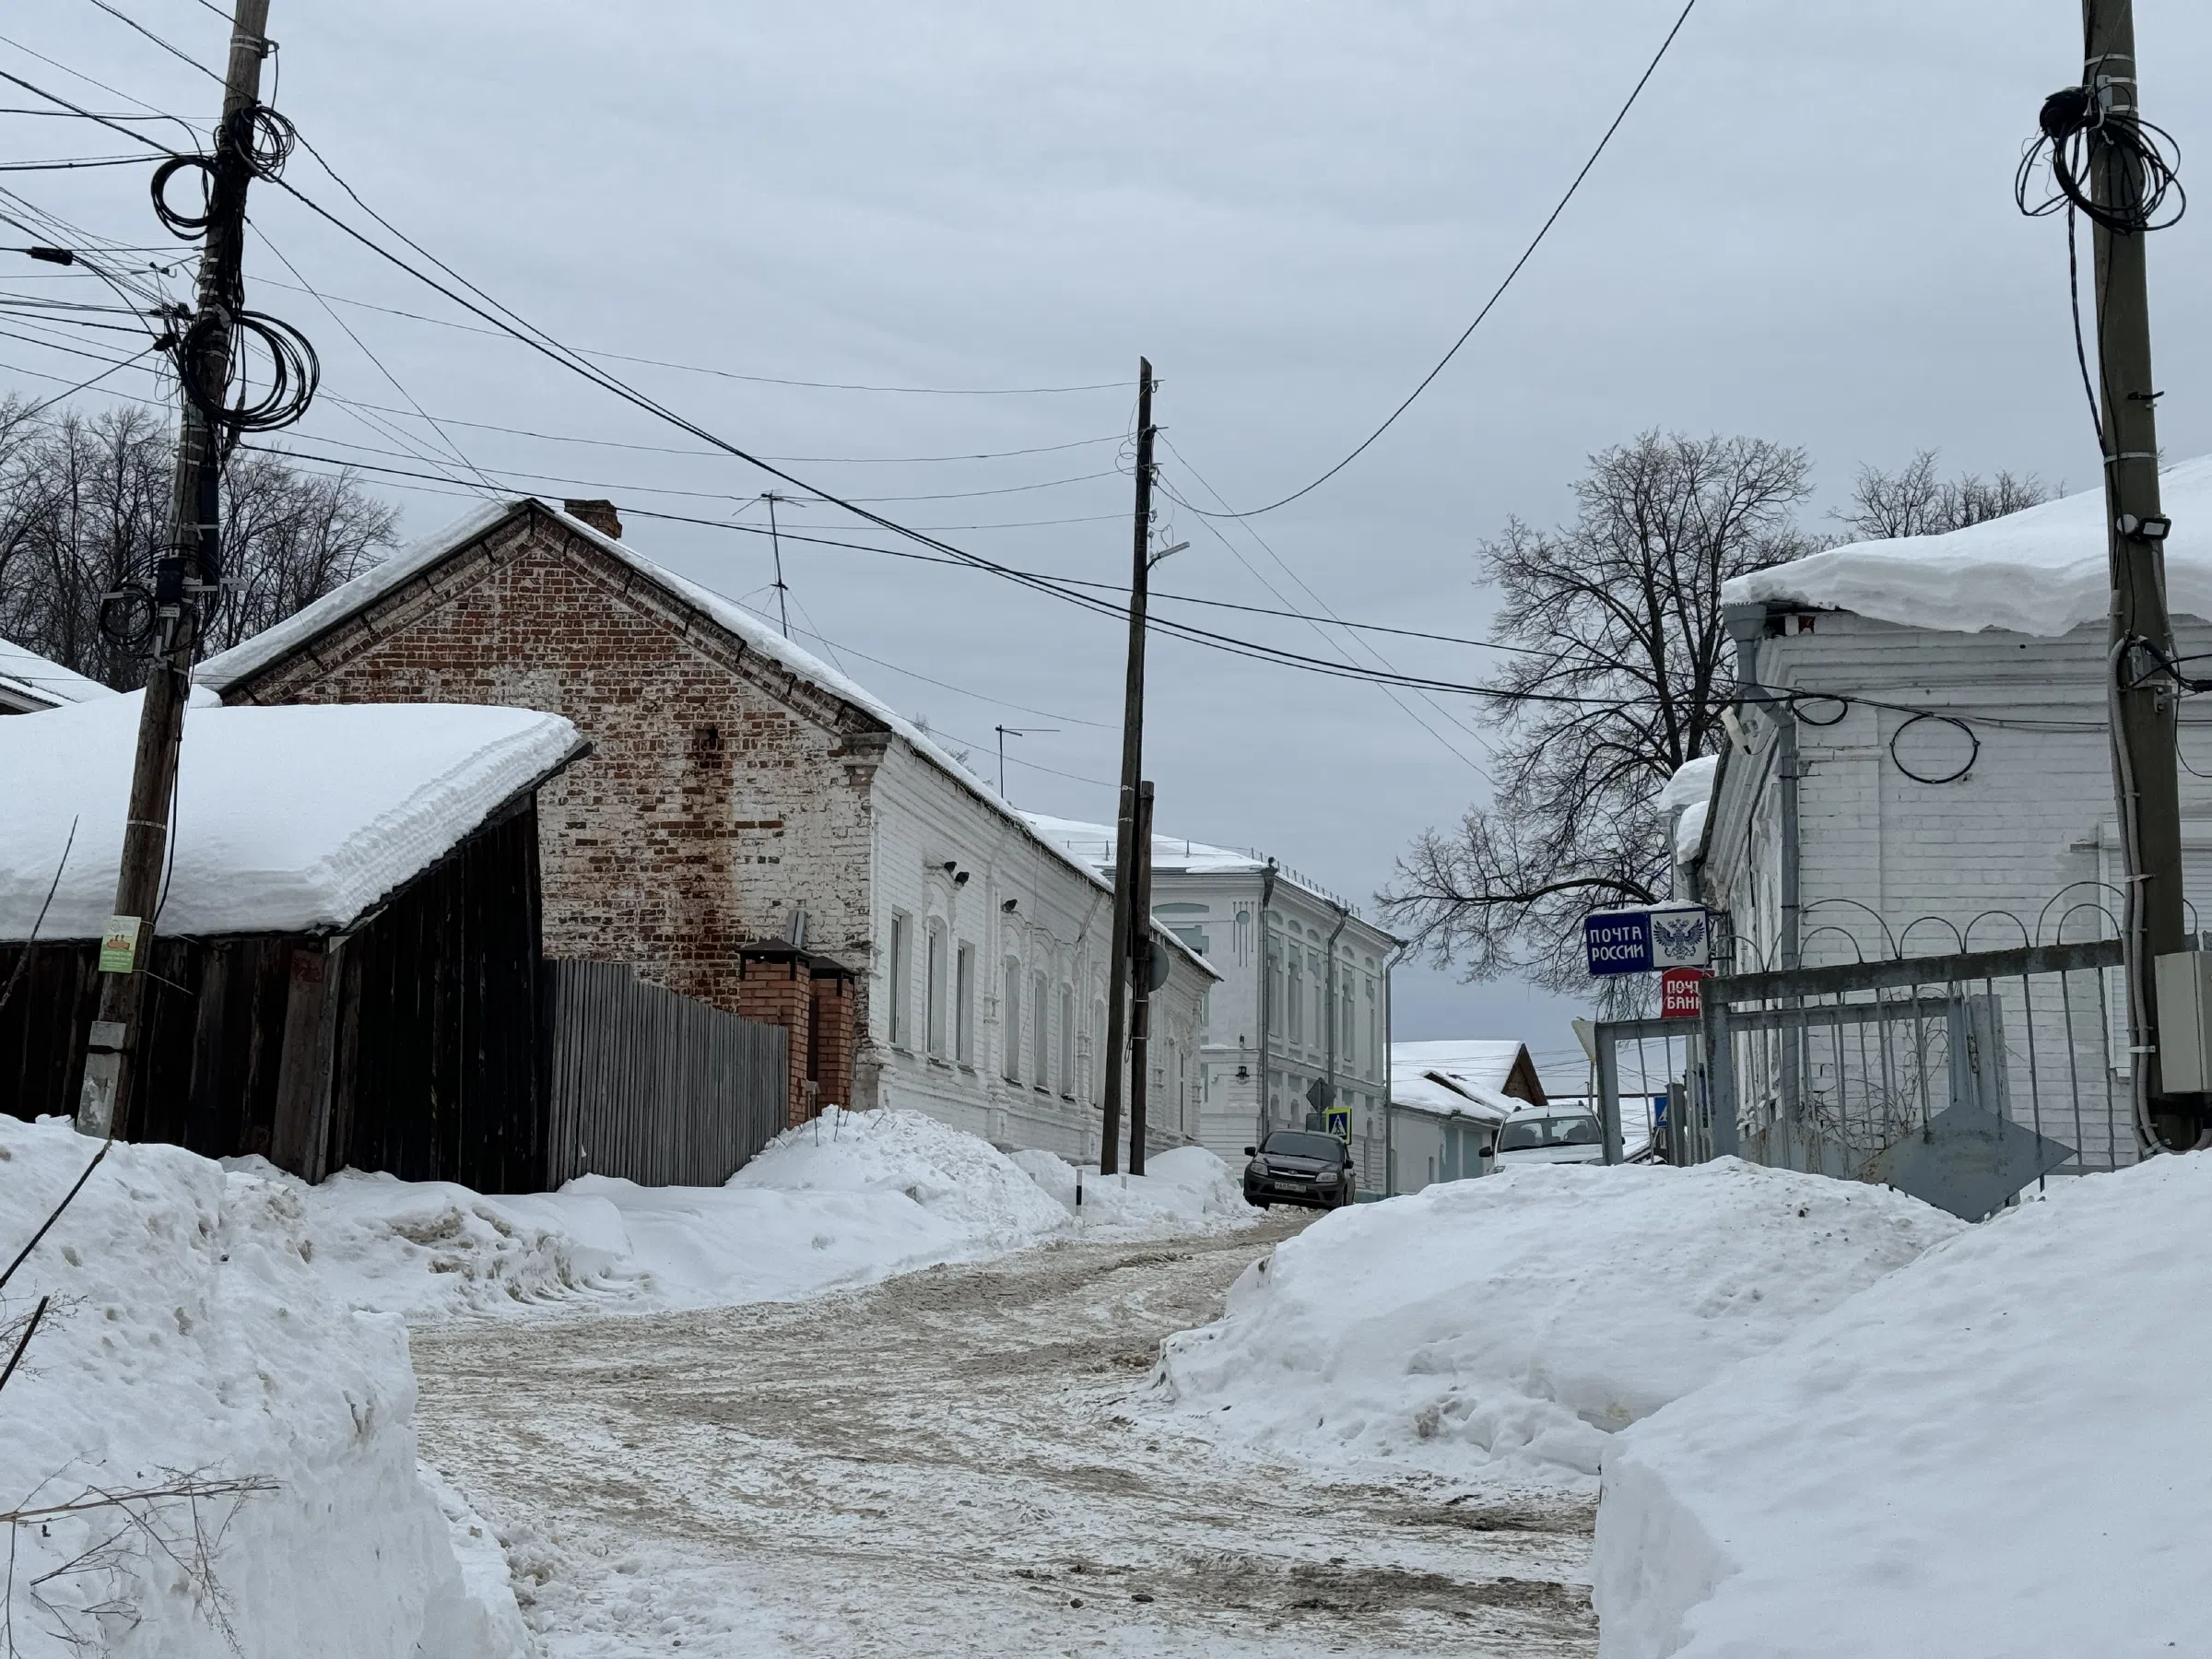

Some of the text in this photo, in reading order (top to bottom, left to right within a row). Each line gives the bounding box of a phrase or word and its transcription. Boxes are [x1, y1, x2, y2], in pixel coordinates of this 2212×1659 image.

[1590, 926, 1642, 943] ПОЧТА
[1592, 944, 1644, 961] РОССИИ
[1666, 980, 1700, 994] ПОЧТ
